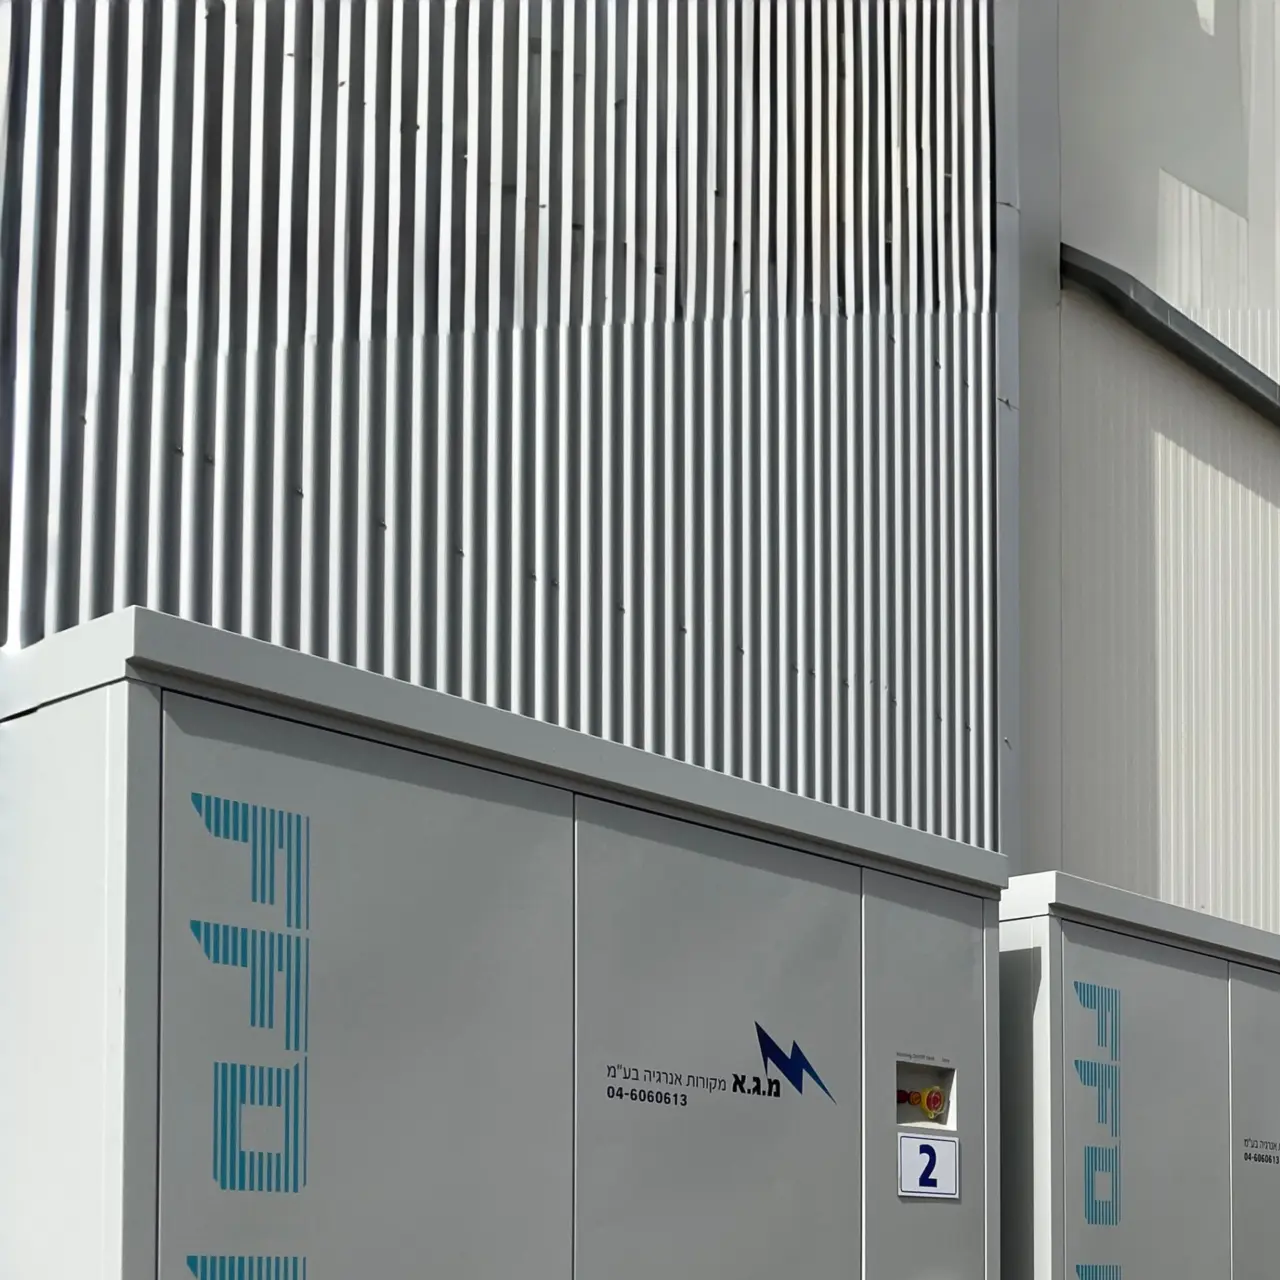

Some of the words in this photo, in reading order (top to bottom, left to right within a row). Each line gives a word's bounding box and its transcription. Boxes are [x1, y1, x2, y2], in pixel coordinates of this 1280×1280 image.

[643, 1068, 682, 1086] אנרגיה
[686, 1074, 726, 1093] מקורות
[732, 1073, 781, 1098] מ.ג.א
[606, 1086, 688, 1106] 04-6060613
[918, 1143, 938, 1188] 2
